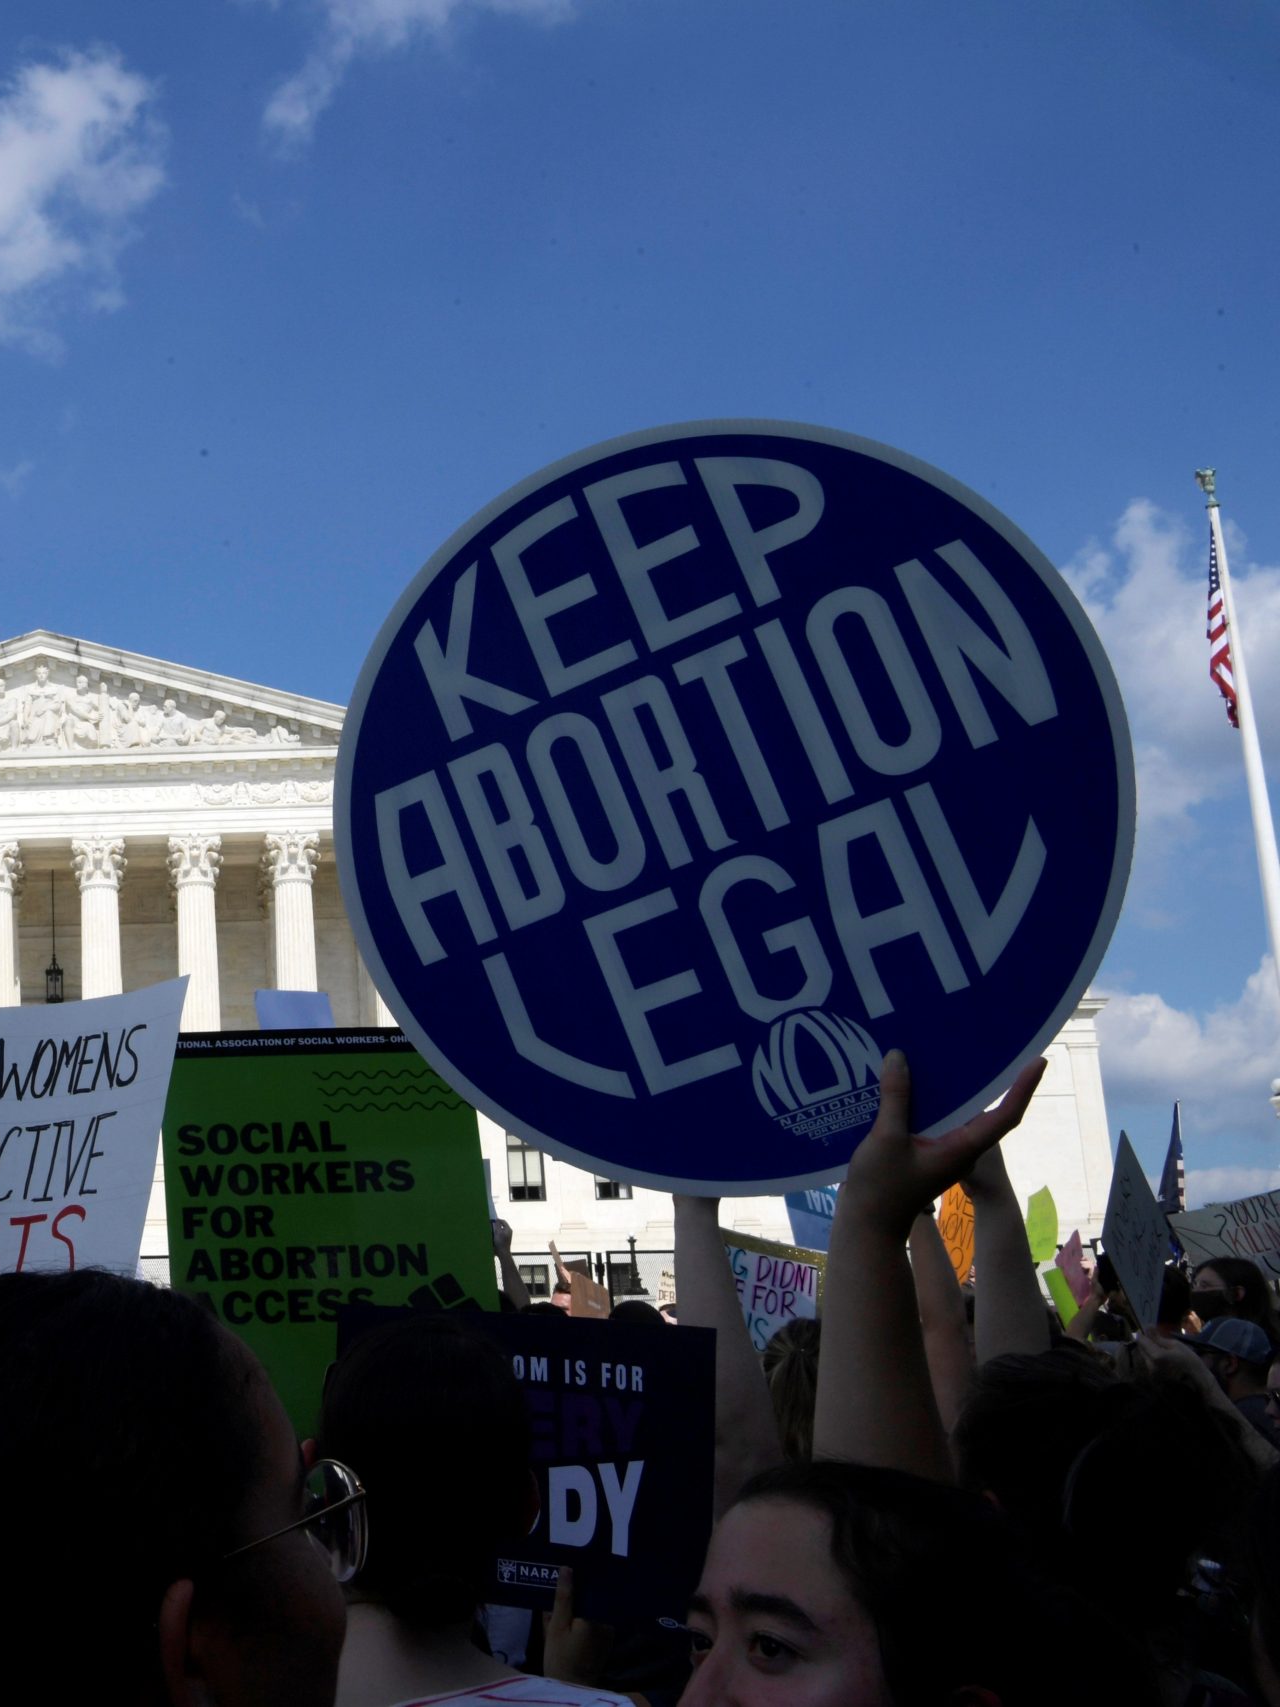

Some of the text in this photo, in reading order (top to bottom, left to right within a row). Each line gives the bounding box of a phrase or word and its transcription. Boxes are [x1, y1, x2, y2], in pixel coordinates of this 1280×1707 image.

[412, 454, 827, 743] KEEP
[372, 536, 1060, 968] ABORTION
[481, 782, 1048, 1101] LEGAL
[176, 1039, 213, 1049] TIONAL
[215, 1037, 282, 1048] ASSOCIATION
[283, 1037, 296, 1046] OF
[297, 1036, 334, 1045] SOCIAL
[389, 1034, 409, 1044] OHI
[751, 1009, 885, 1118] NOW
[780, 1086, 880, 1127] NATIONAL
[792, 1100, 879, 1136] ORGANIZATION
[177, 1121, 347, 1156] SOCIAL
[808, 1113, 871, 1139] FOR WOMEN
[179, 1159, 415, 1197] WORKERS
[182, 1205, 275, 1239] FOR
[186, 1243, 429, 1283] ABORTION
[752, 1284, 798, 1318] FOR
[564, 1358, 587, 1386] IS
[601, 1362, 643, 1393] FOR
[525, 1391, 644, 1459] ERY
[530, 1459, 645, 1558] DY
[520, 1565, 560, 1580] NARA
